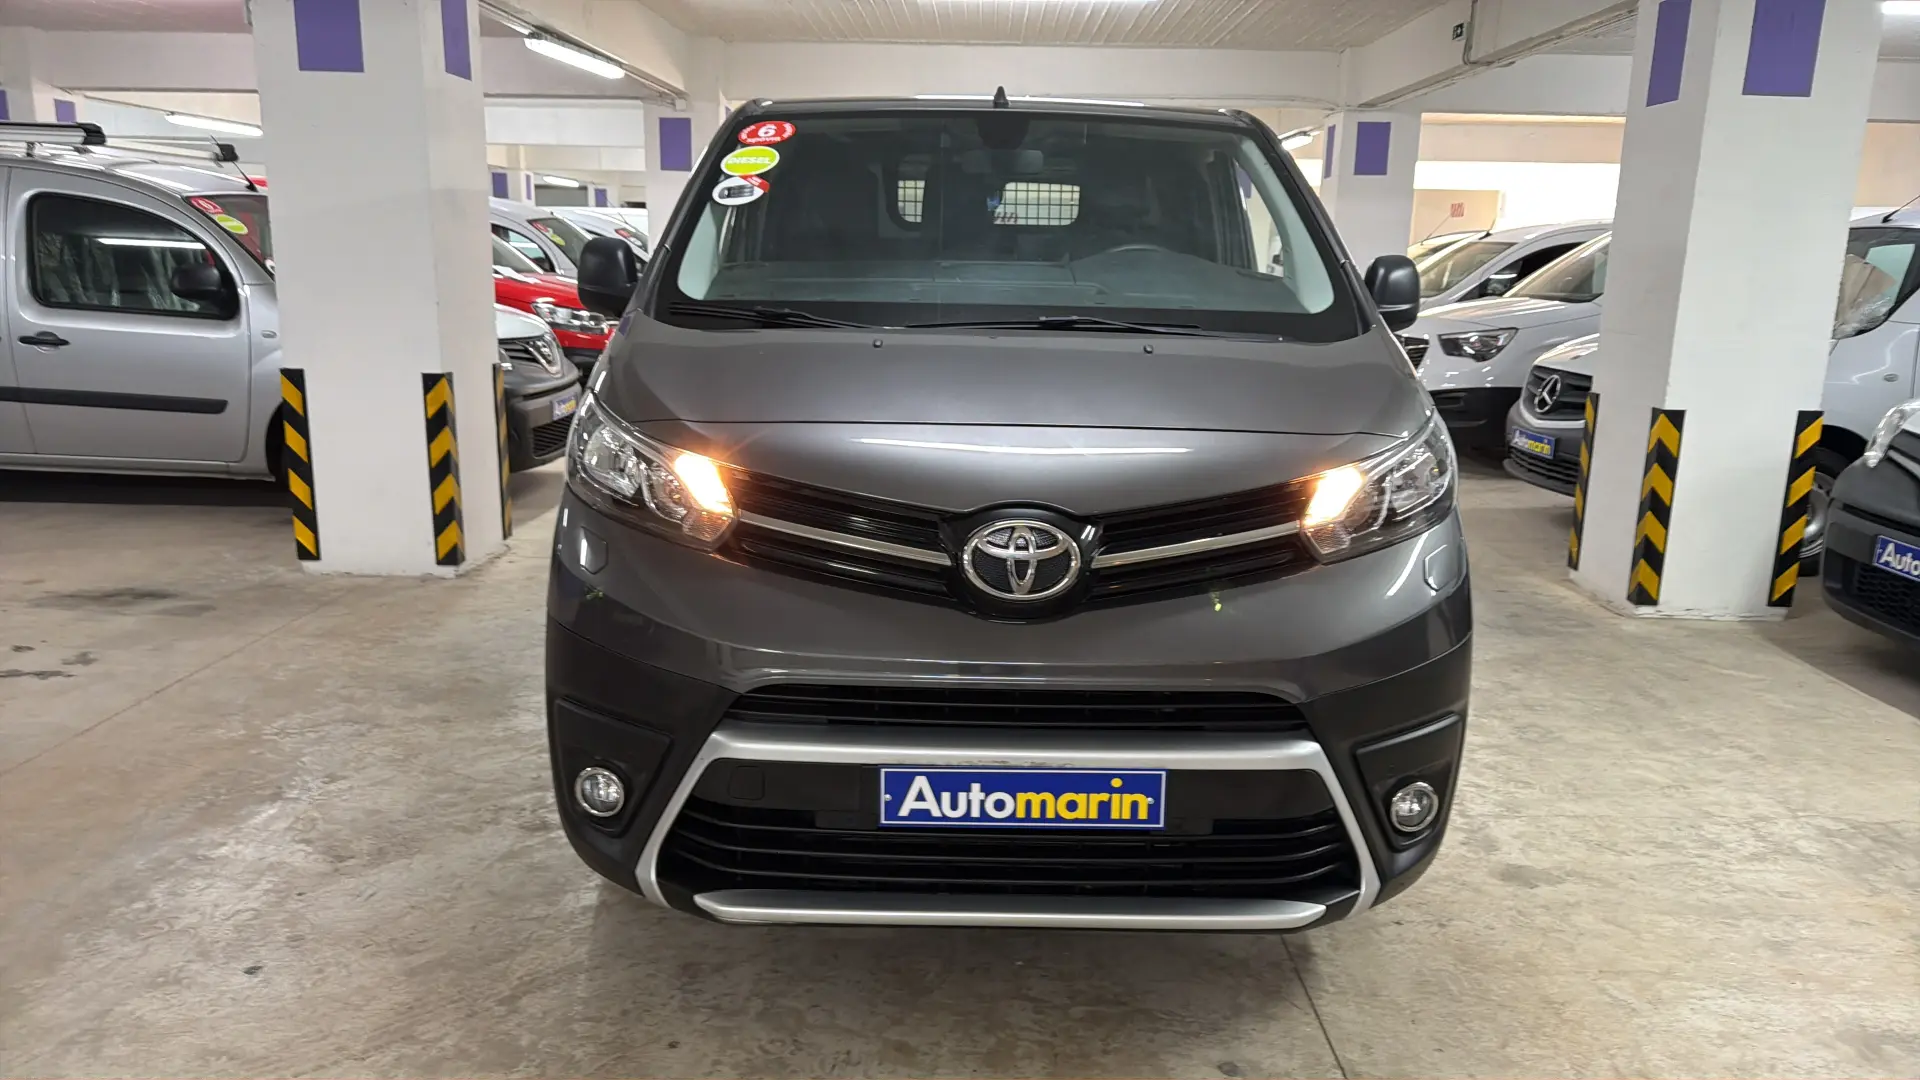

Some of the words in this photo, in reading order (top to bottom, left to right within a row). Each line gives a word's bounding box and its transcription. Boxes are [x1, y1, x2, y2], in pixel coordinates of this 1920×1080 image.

[757, 124, 777, 137] 6
[727, 156, 771, 164] DIESEL
[897, 775, 1149, 820] Automarin
